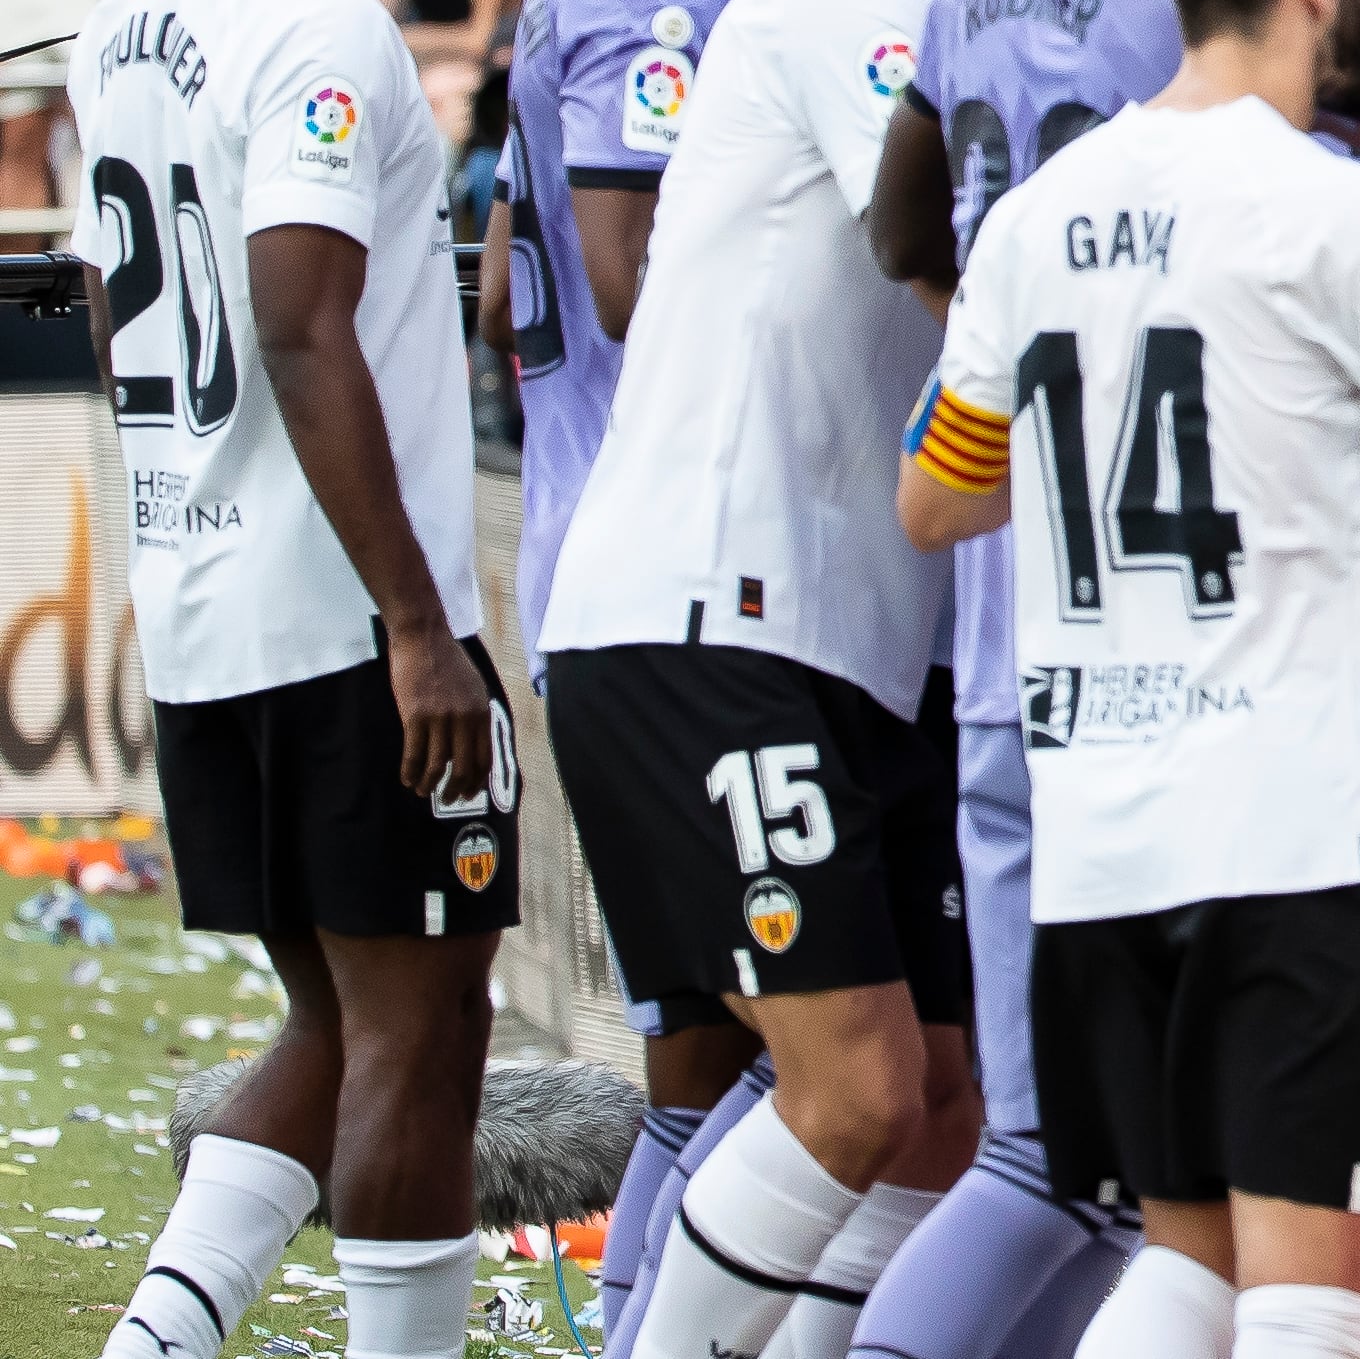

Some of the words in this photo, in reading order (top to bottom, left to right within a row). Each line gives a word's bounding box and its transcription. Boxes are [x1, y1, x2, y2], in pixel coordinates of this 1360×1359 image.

[90, 154, 238, 437] 20
[1011, 326, 1246, 624] 14
[706, 743, 836, 874] 15
